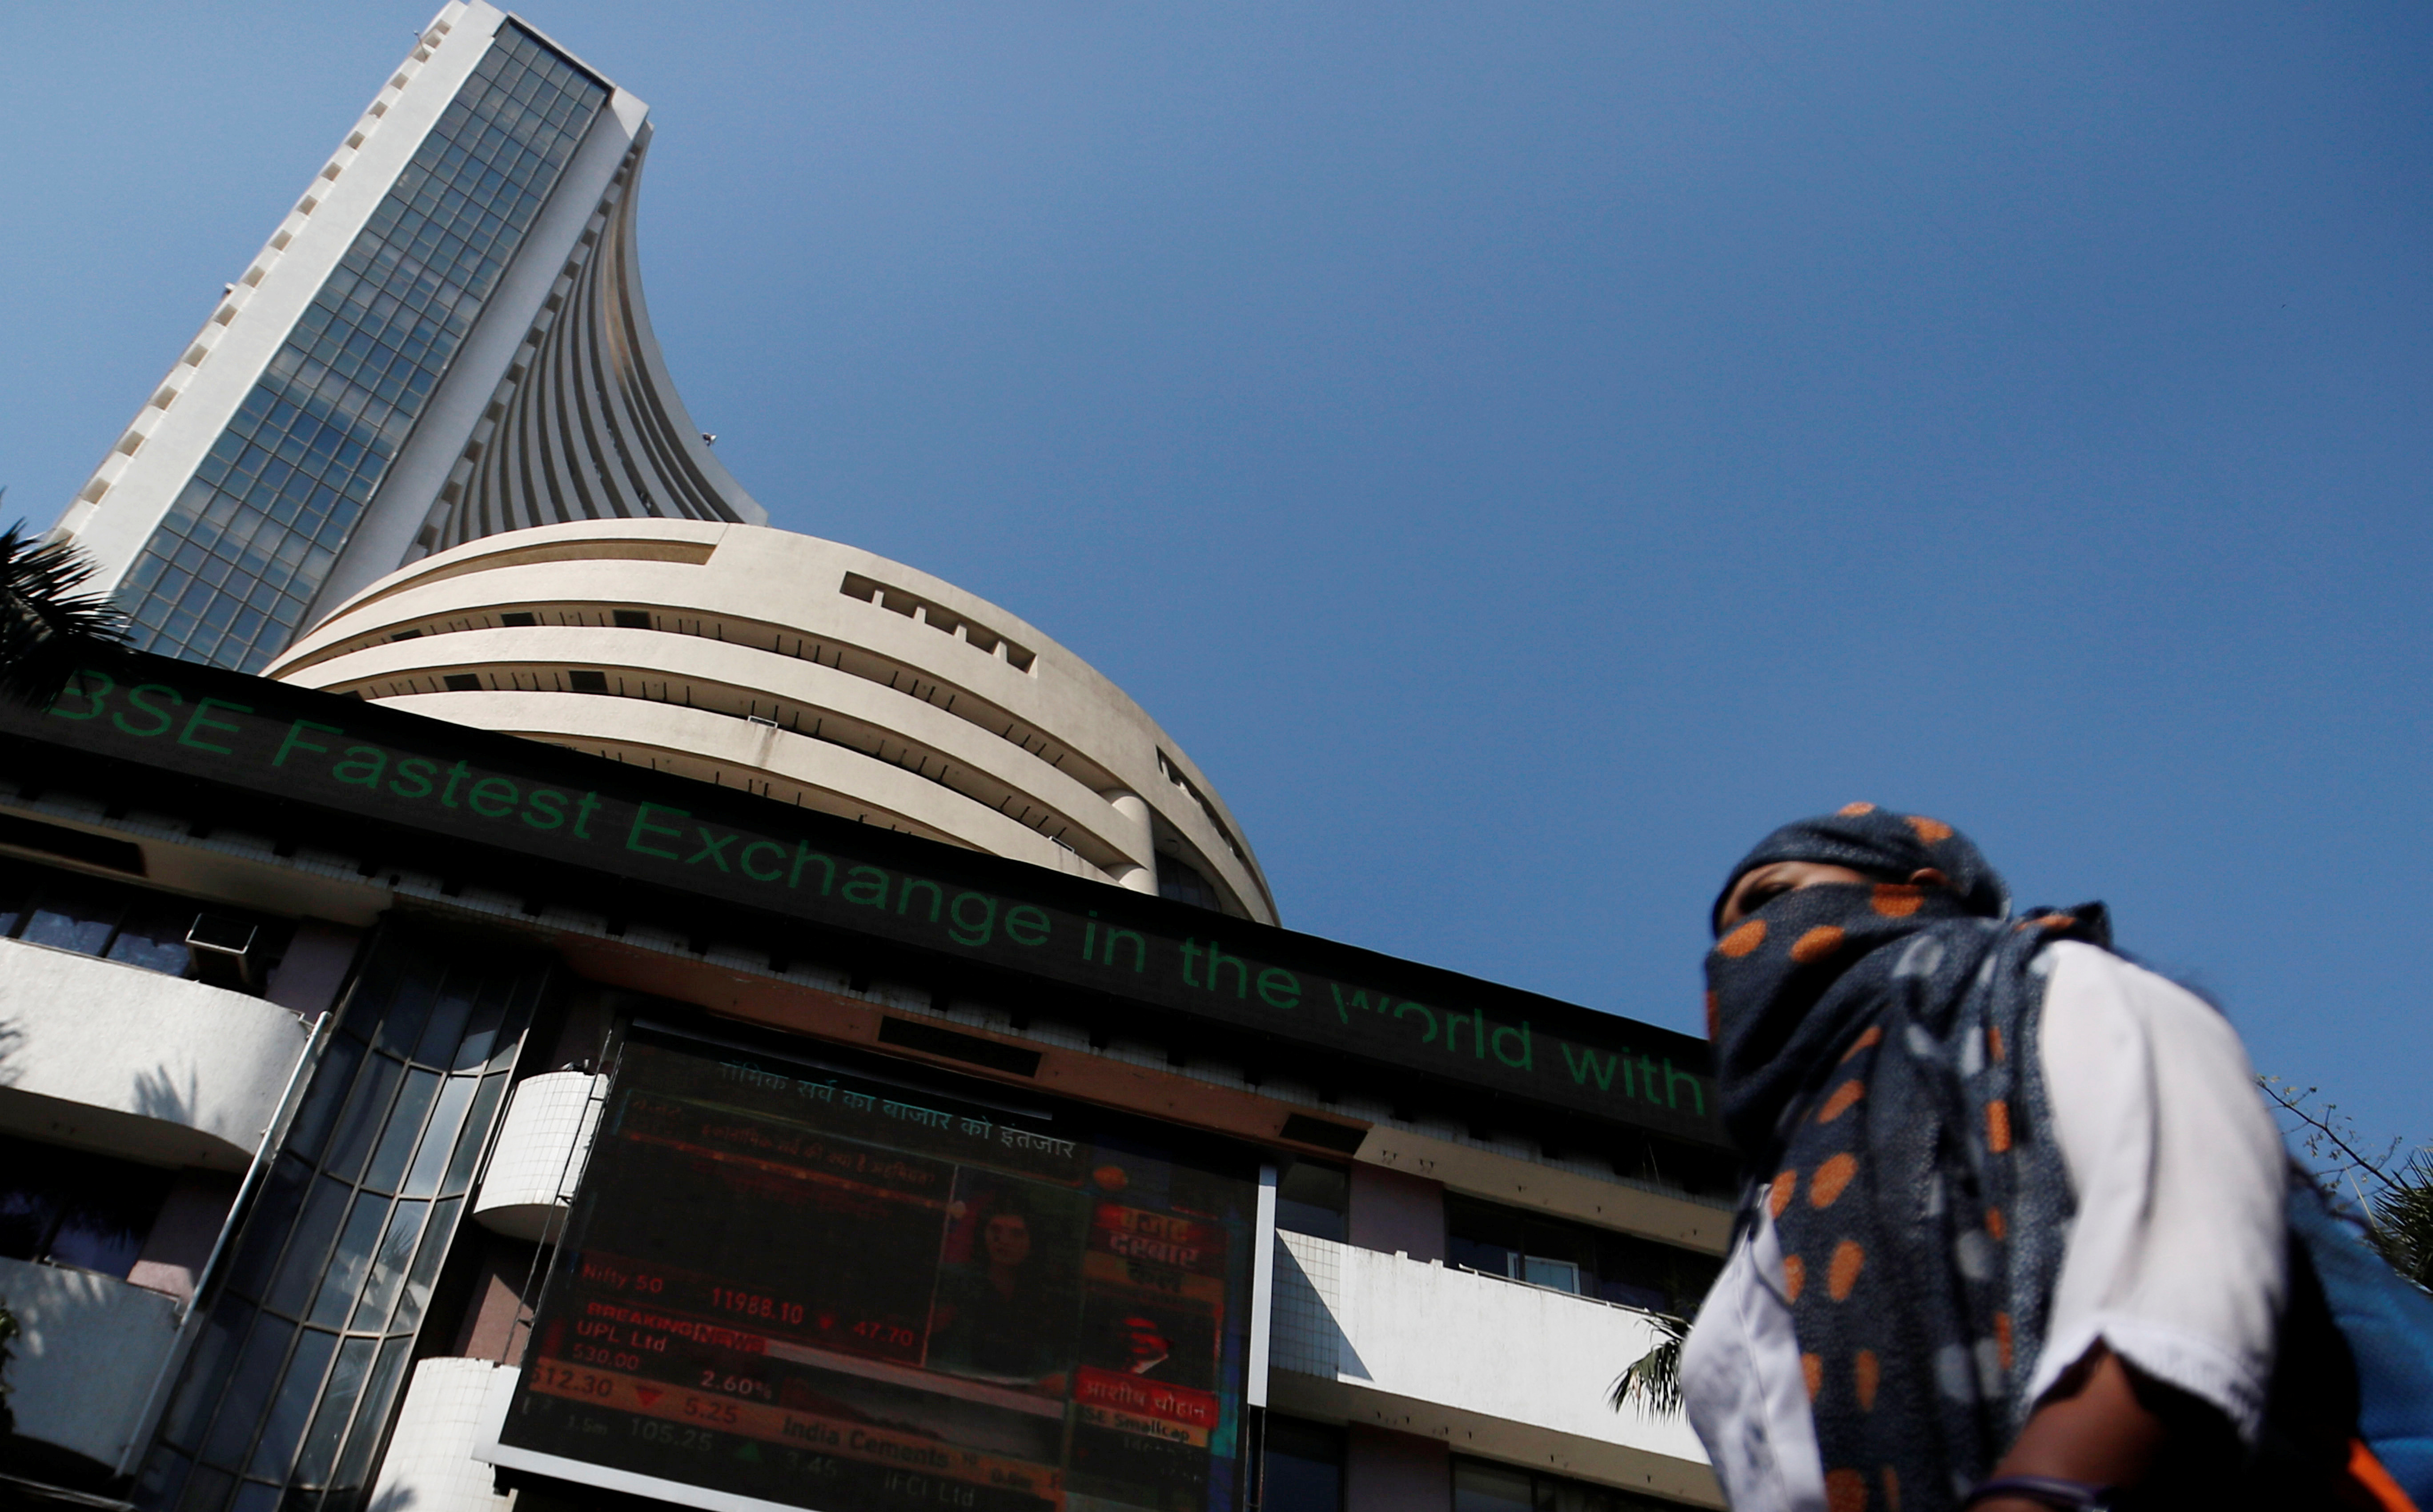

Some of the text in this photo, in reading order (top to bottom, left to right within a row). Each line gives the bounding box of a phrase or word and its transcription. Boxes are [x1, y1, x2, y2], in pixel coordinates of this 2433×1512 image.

[43, 669, 253, 755] BSE
[272, 718, 602, 839] Fastest
[625, 800, 1051, 946] Exchange
[1083, 910, 1146, 973] in
[1179, 937, 1301, 1009] the
[1561, 1043, 1706, 1115] with
[843, 1090, 877, 1113] का
[883, 1099, 953, 1130] बाजार
[960, 1115, 992, 1139] को
[1000, 1122, 1076, 1159] इंतजार
[582, 1263, 664, 1294] Nifty 50
[713, 1287, 803, 1325] 11988.10
[577, 1320, 666, 1352] UPL Ltd
[700, 1370, 772, 1400] 2.60%
[631, 1417, 713, 1452] 105.25
[684, 1396, 739, 1423] 5.25
[783, 1416, 839, 1446] India
[850, 1429, 948, 1468] Cements
